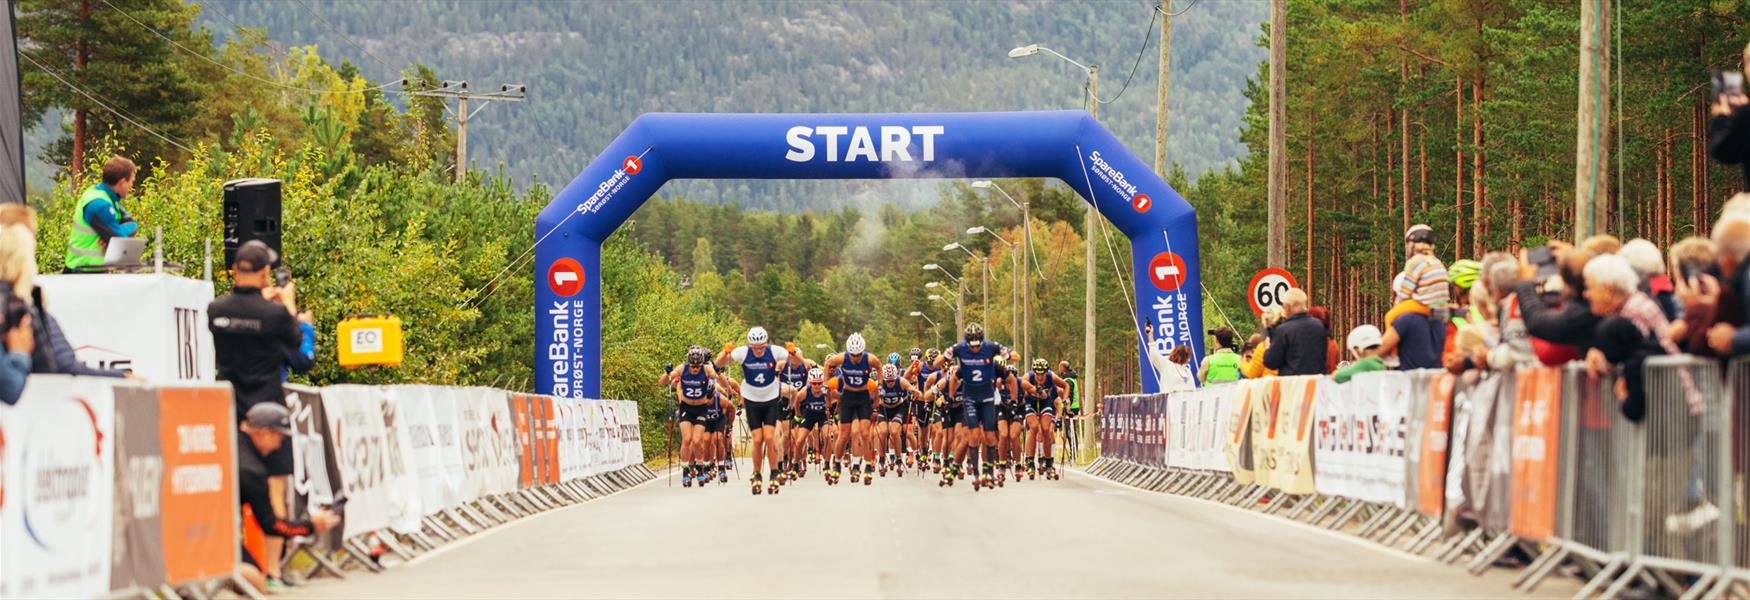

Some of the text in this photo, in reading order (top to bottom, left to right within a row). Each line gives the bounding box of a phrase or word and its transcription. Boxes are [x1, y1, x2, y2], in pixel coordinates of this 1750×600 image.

[785, 126, 944, 162] START
[1089, 150, 1137, 197] SpareBank
[577, 168, 625, 214] SpareBank
[1257, 281, 1289, 307] 60
[549, 300, 569, 398] areBank
[754, 373, 765, 384] 4
[847, 376, 863, 385] 13
[971, 369, 983, 381] 2
[686, 387, 702, 397] 25
